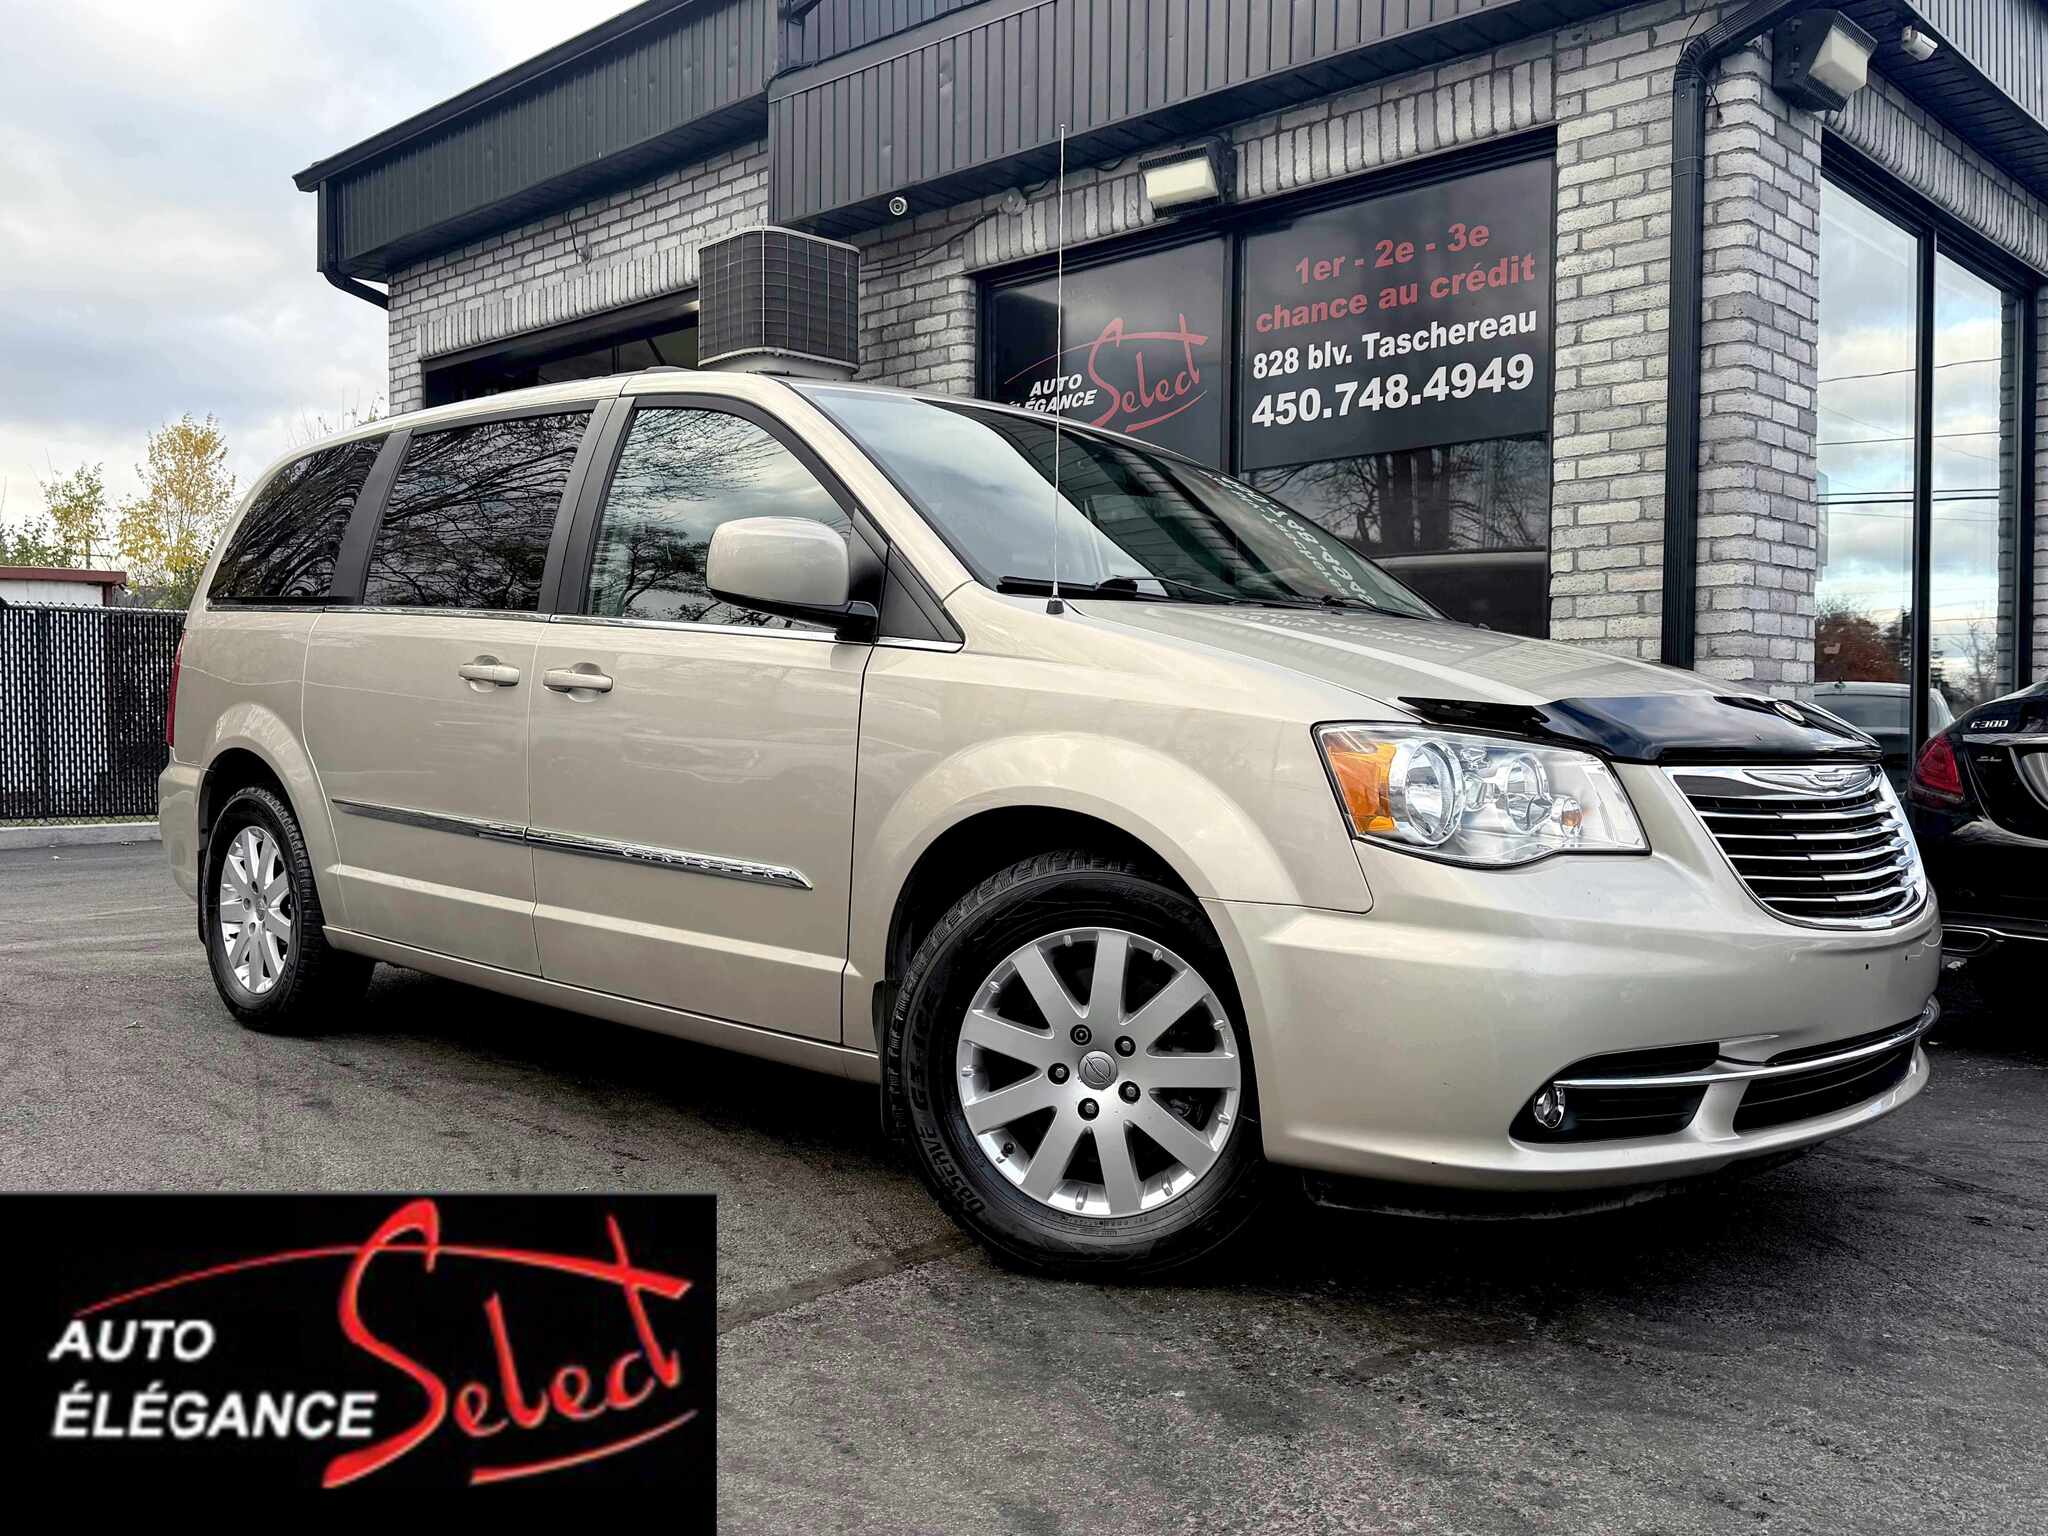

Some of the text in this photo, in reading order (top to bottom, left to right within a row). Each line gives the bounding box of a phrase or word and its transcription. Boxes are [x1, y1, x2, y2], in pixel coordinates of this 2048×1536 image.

[1295, 255, 1346, 285] 1er
[1375, 239, 1415, 269] 2e
[1447, 222, 1490, 252] 3e
[1256, 252, 1536, 333] chance au crédit
[1087, 313, 1208, 427] Select
[1253, 309, 1537, 380] 828 blv. Taschereau
[1029, 373, 1083, 398] AUTO
[1251, 353, 1535, 428] 450.748.4949
[1970, 719, 2009, 730] C300
